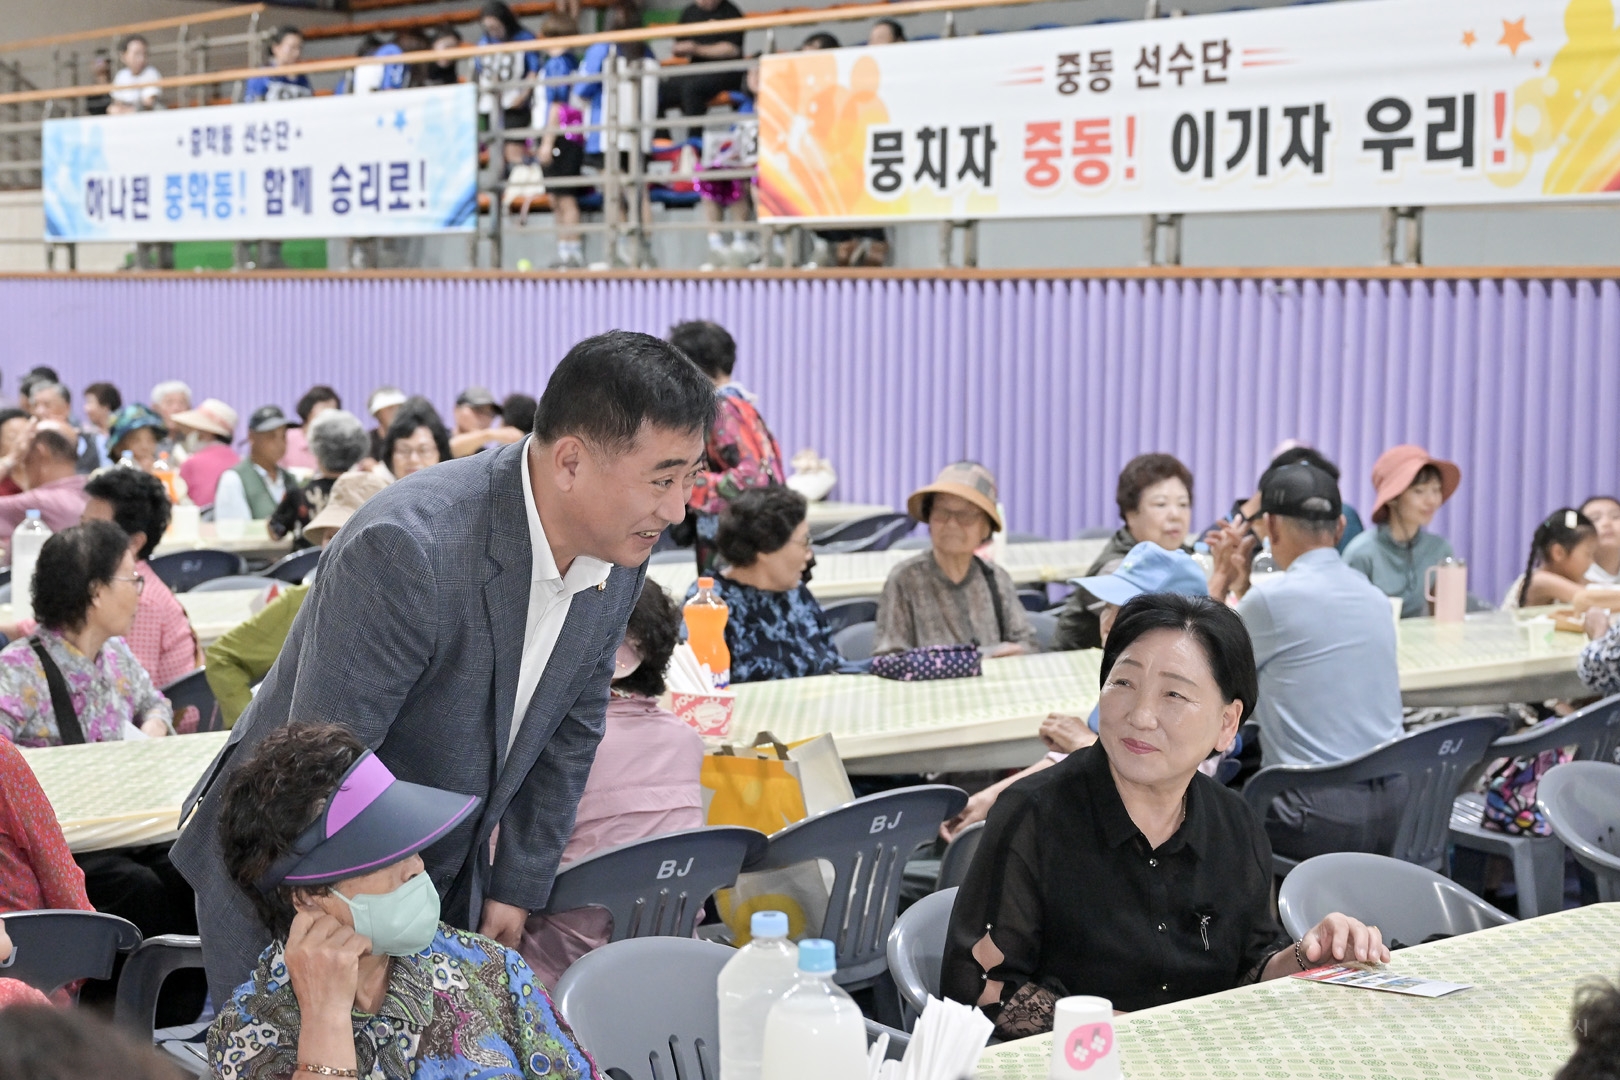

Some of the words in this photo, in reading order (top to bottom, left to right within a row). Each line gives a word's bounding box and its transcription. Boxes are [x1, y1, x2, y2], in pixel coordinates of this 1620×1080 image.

[1056, 49, 1113, 95] 중동
[1134, 38, 1232, 89] 선수단
[190, 127, 233, 157] 중학동
[244, 120, 290, 153] 선수단
[870, 123, 997, 193] 뭉치자
[1023, 115, 1136, 188] 중동!
[1171, 102, 1331, 179] 이기자
[1361, 91, 1508, 172] 우리!
[86, 174, 149, 220] 하나된
[165, 169, 247, 220] 중학동!
[264, 166, 312, 215] 함께
[330, 160, 426, 214] 승리로!
[1438, 738, 1464, 755] BJ
[868, 811, 903, 834] BJ
[656, 857, 695, 880] BJ
